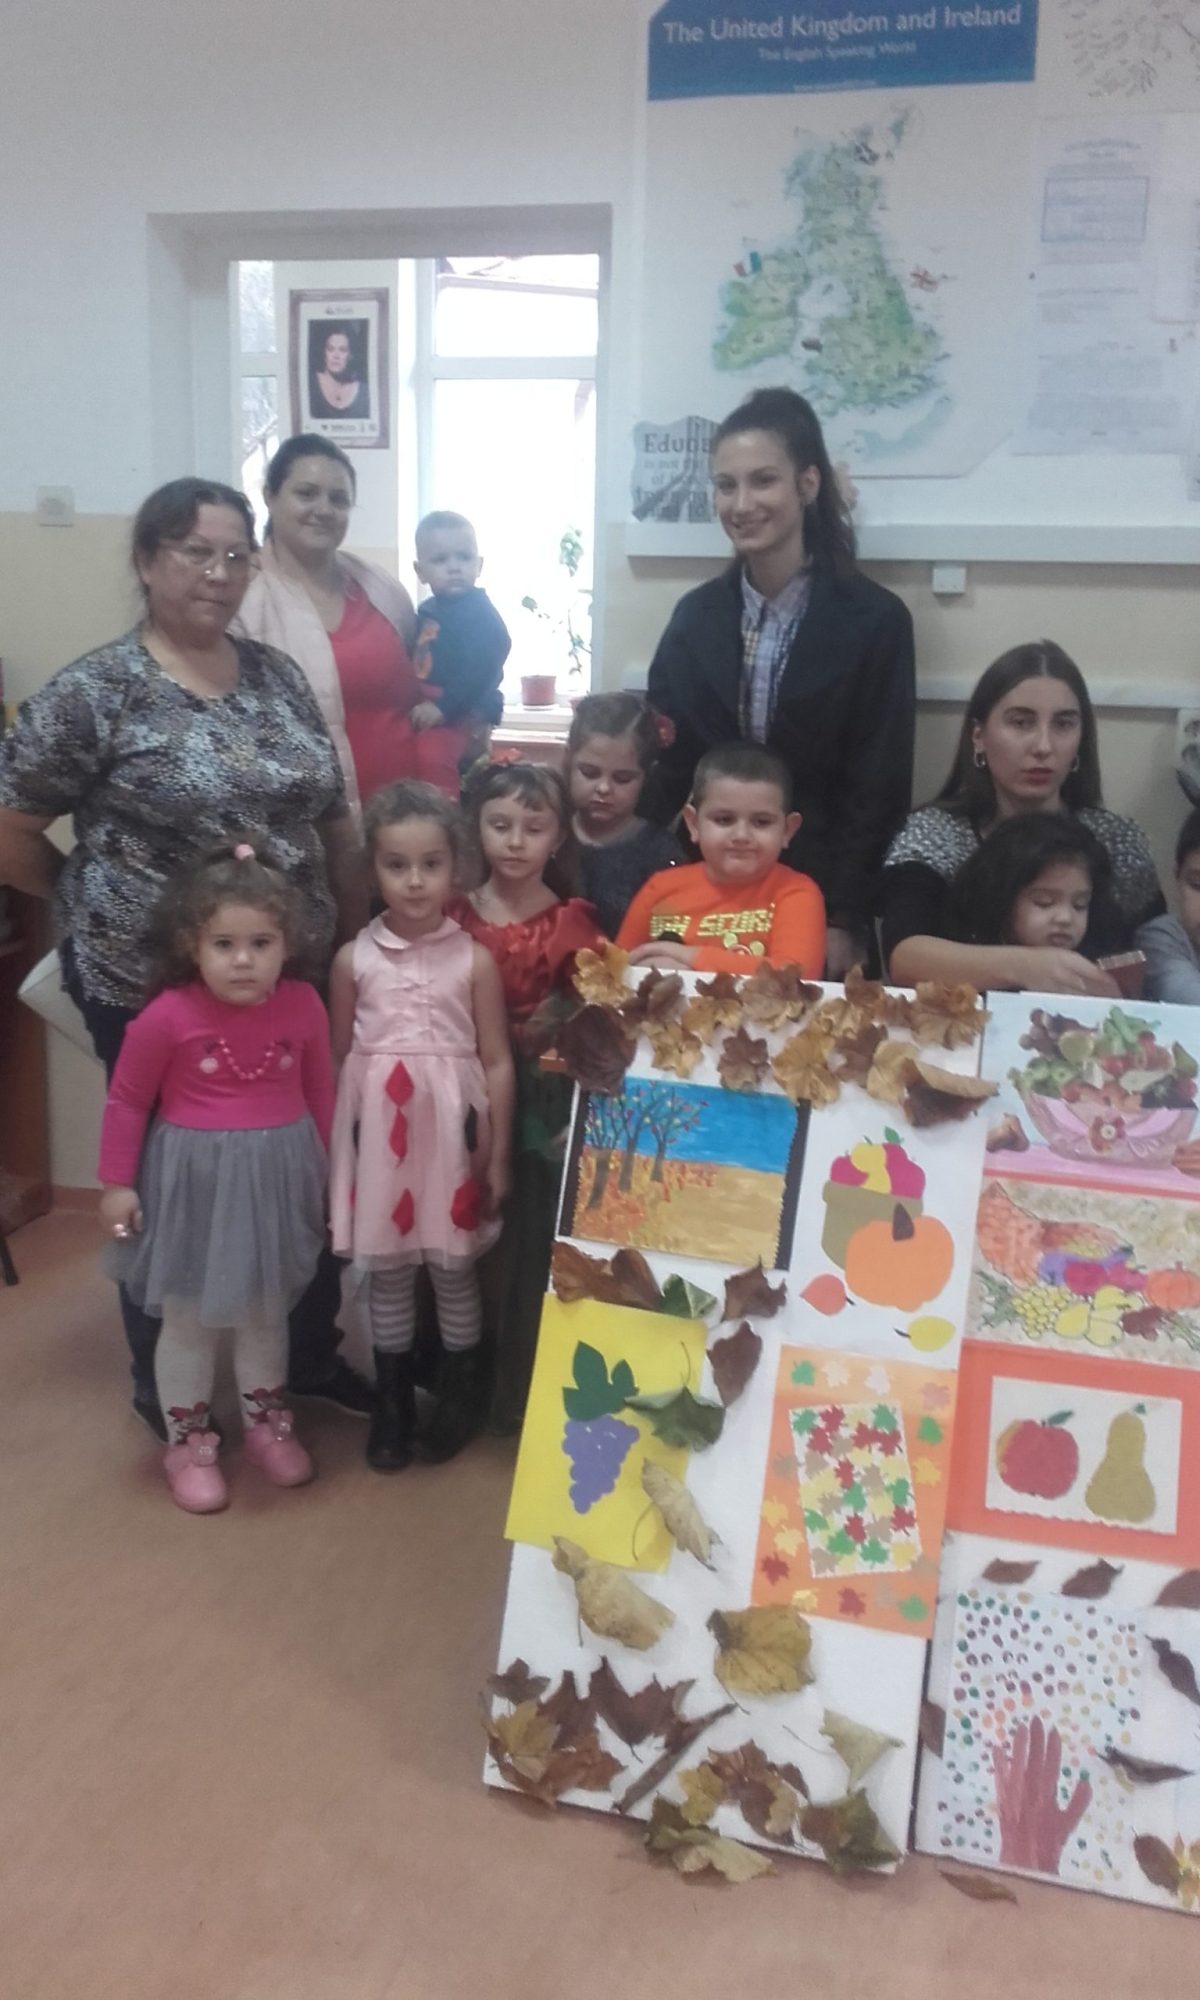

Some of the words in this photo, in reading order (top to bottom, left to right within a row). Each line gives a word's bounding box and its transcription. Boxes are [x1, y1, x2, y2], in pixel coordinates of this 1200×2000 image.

[663, 21, 704, 42] The
[711, 16, 783, 40] United
[792, 12, 888, 41] Kingdom
[896, 6, 936, 30] and
[944, 4, 1021, 28] Ireland
